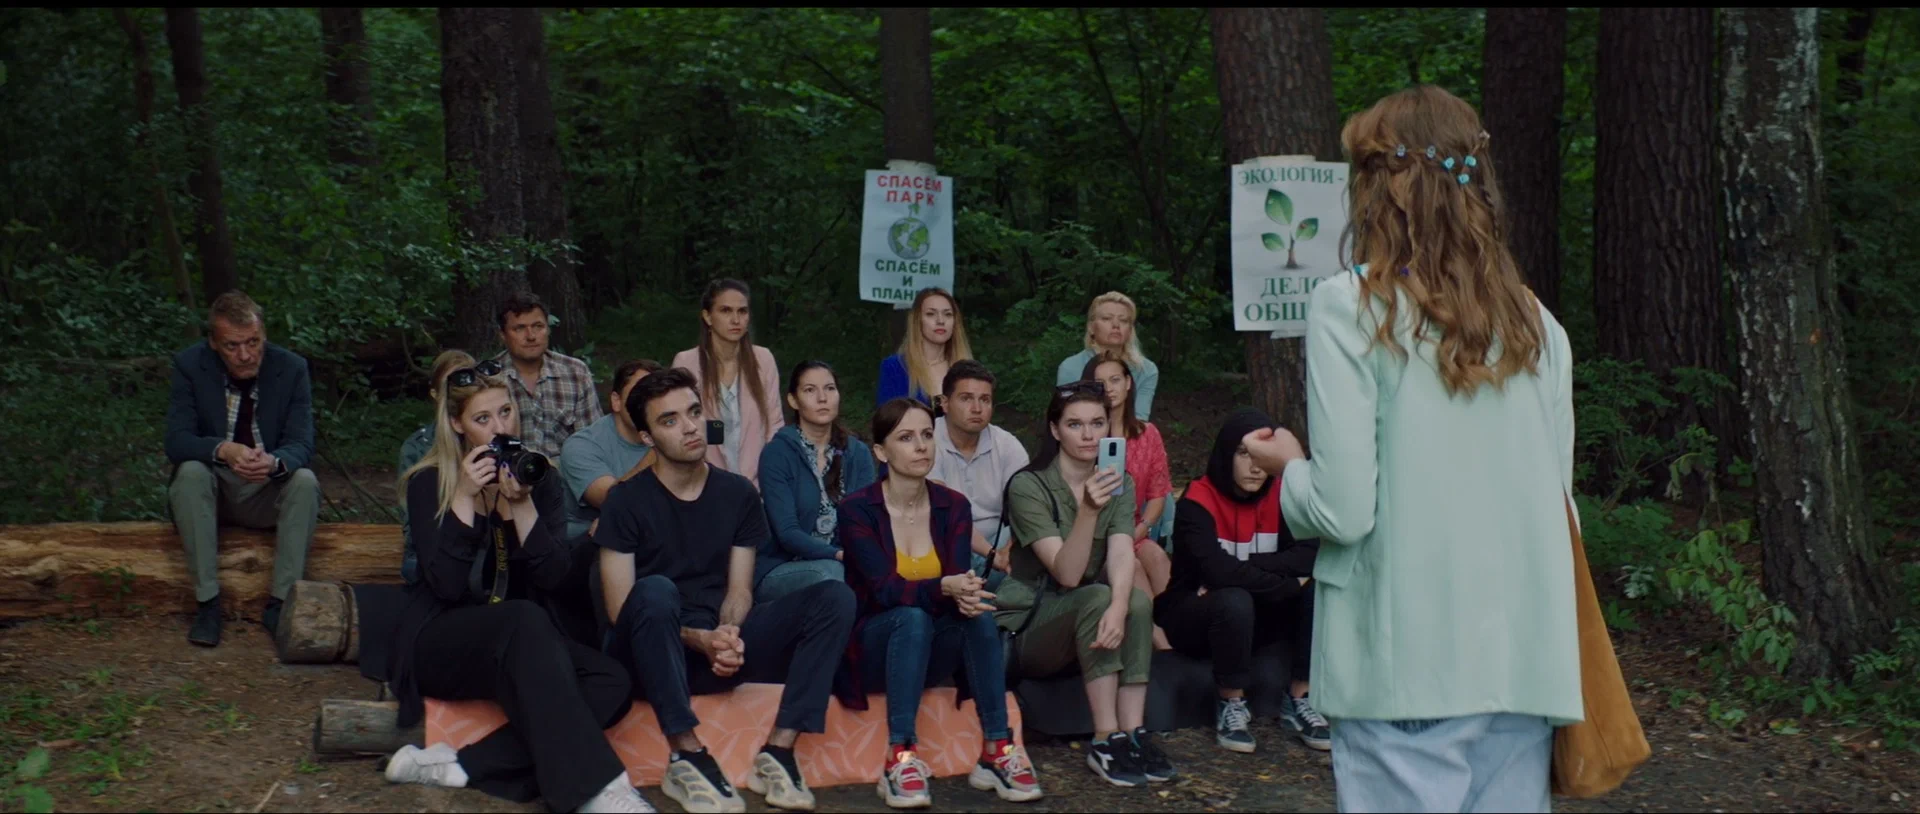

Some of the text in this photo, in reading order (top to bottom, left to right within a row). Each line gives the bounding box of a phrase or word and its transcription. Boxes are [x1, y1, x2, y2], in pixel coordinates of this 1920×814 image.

[1238, 167, 1334, 186] ЭКОЛОГИЯ
[886, 190, 935, 206] ПАРК
[875, 259, 941, 275] СПАСЁМ
[902, 275, 913, 287] И
[872, 287, 919, 301] ПЛАН
